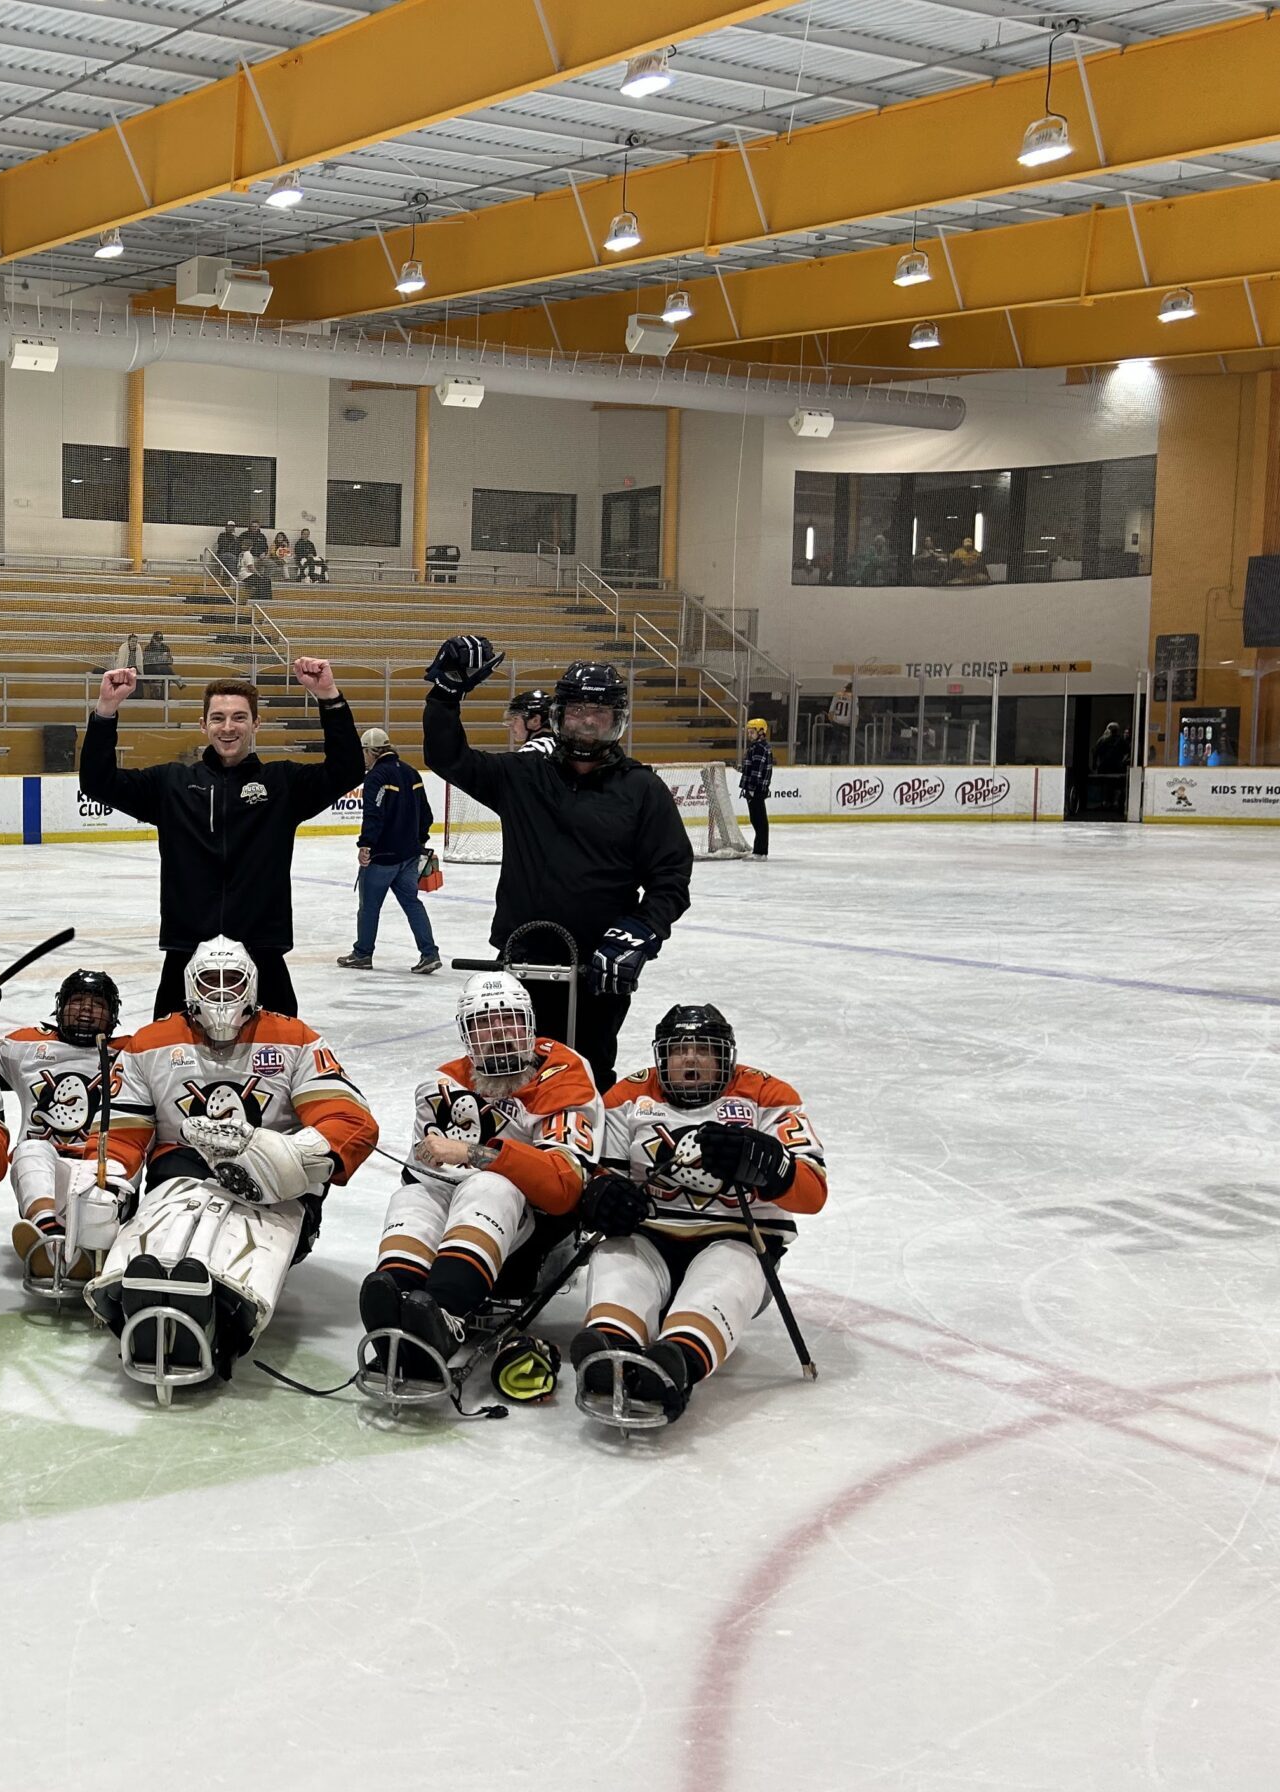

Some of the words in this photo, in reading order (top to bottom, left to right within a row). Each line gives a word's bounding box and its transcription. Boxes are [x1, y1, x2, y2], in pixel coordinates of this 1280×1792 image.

[906, 663, 953, 677] TERRY
[961, 662, 1008, 677] CRISP
[1023, 663, 1077, 673] RINK
[835, 701, 849, 716] 91
[853, 778, 870, 792] Dr
[911, 777, 929, 791] Dr
[974, 777, 993, 790] Dr
[1211, 785, 1237, 794] KIDS
[1240, 786, 1262, 794] TRY
[774, 788, 802, 798] need.
[841, 782, 880, 807] Pepper
[899, 781, 941, 806] Pepper
[961, 781, 1006, 806] Pepper
[79, 803, 114, 817] CLUB
[604, 928, 645, 946] CM
[253, 1053, 285, 1066] SLED
[717, 1106, 753, 1119] SLED
[541, 1110, 594, 1156] 45
[475, 1211, 505, 1235] TRON
